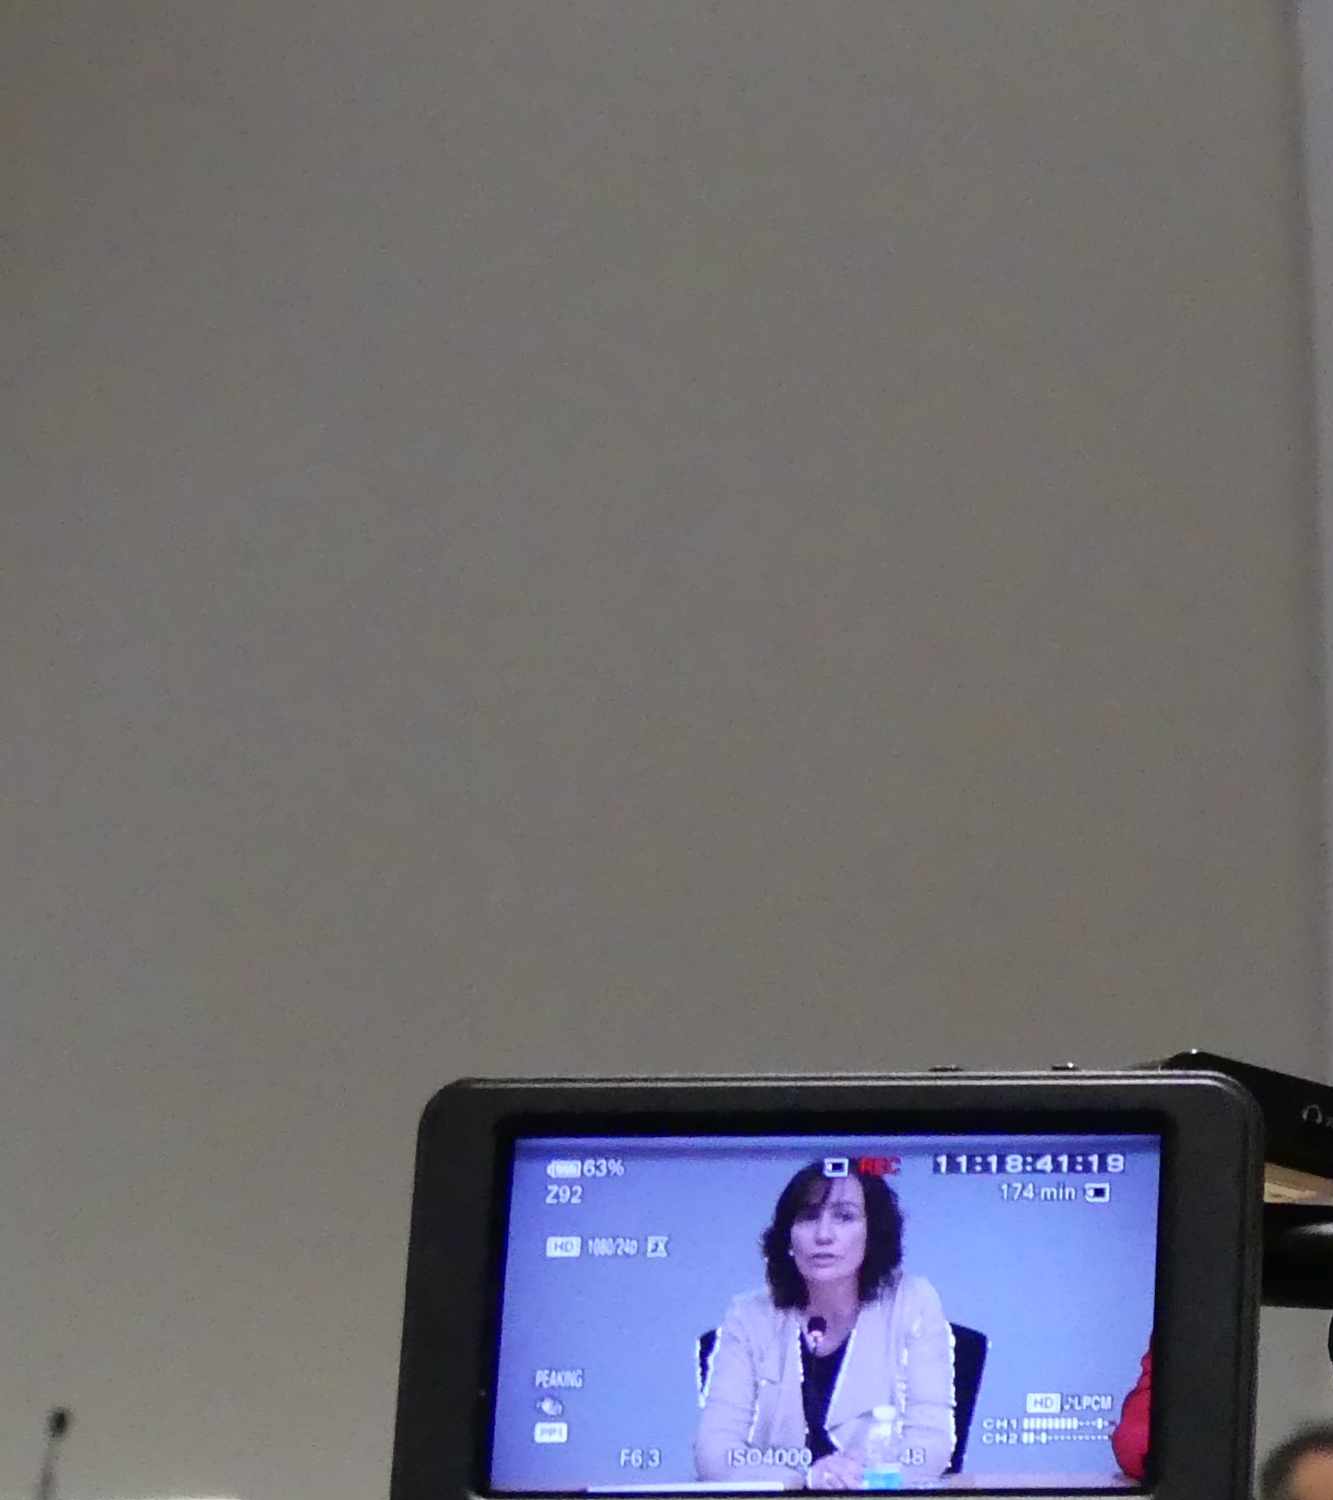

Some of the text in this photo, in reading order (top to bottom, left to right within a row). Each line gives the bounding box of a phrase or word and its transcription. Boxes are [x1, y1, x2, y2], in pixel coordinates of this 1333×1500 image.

[583, 1159, 625, 1177] 63%
[546, 1185, 583, 1204] Z92
[1001, 1182, 1076, 1200] 174 min
[535, 1369, 583, 1389] PEAKING
[1075, 1395, 1112, 1410] LPCM
[982, 1418, 1018, 1430] CH1
[982, 1432, 1019, 1444] CH2
[728, 1448, 812, 1467] ISO4000
